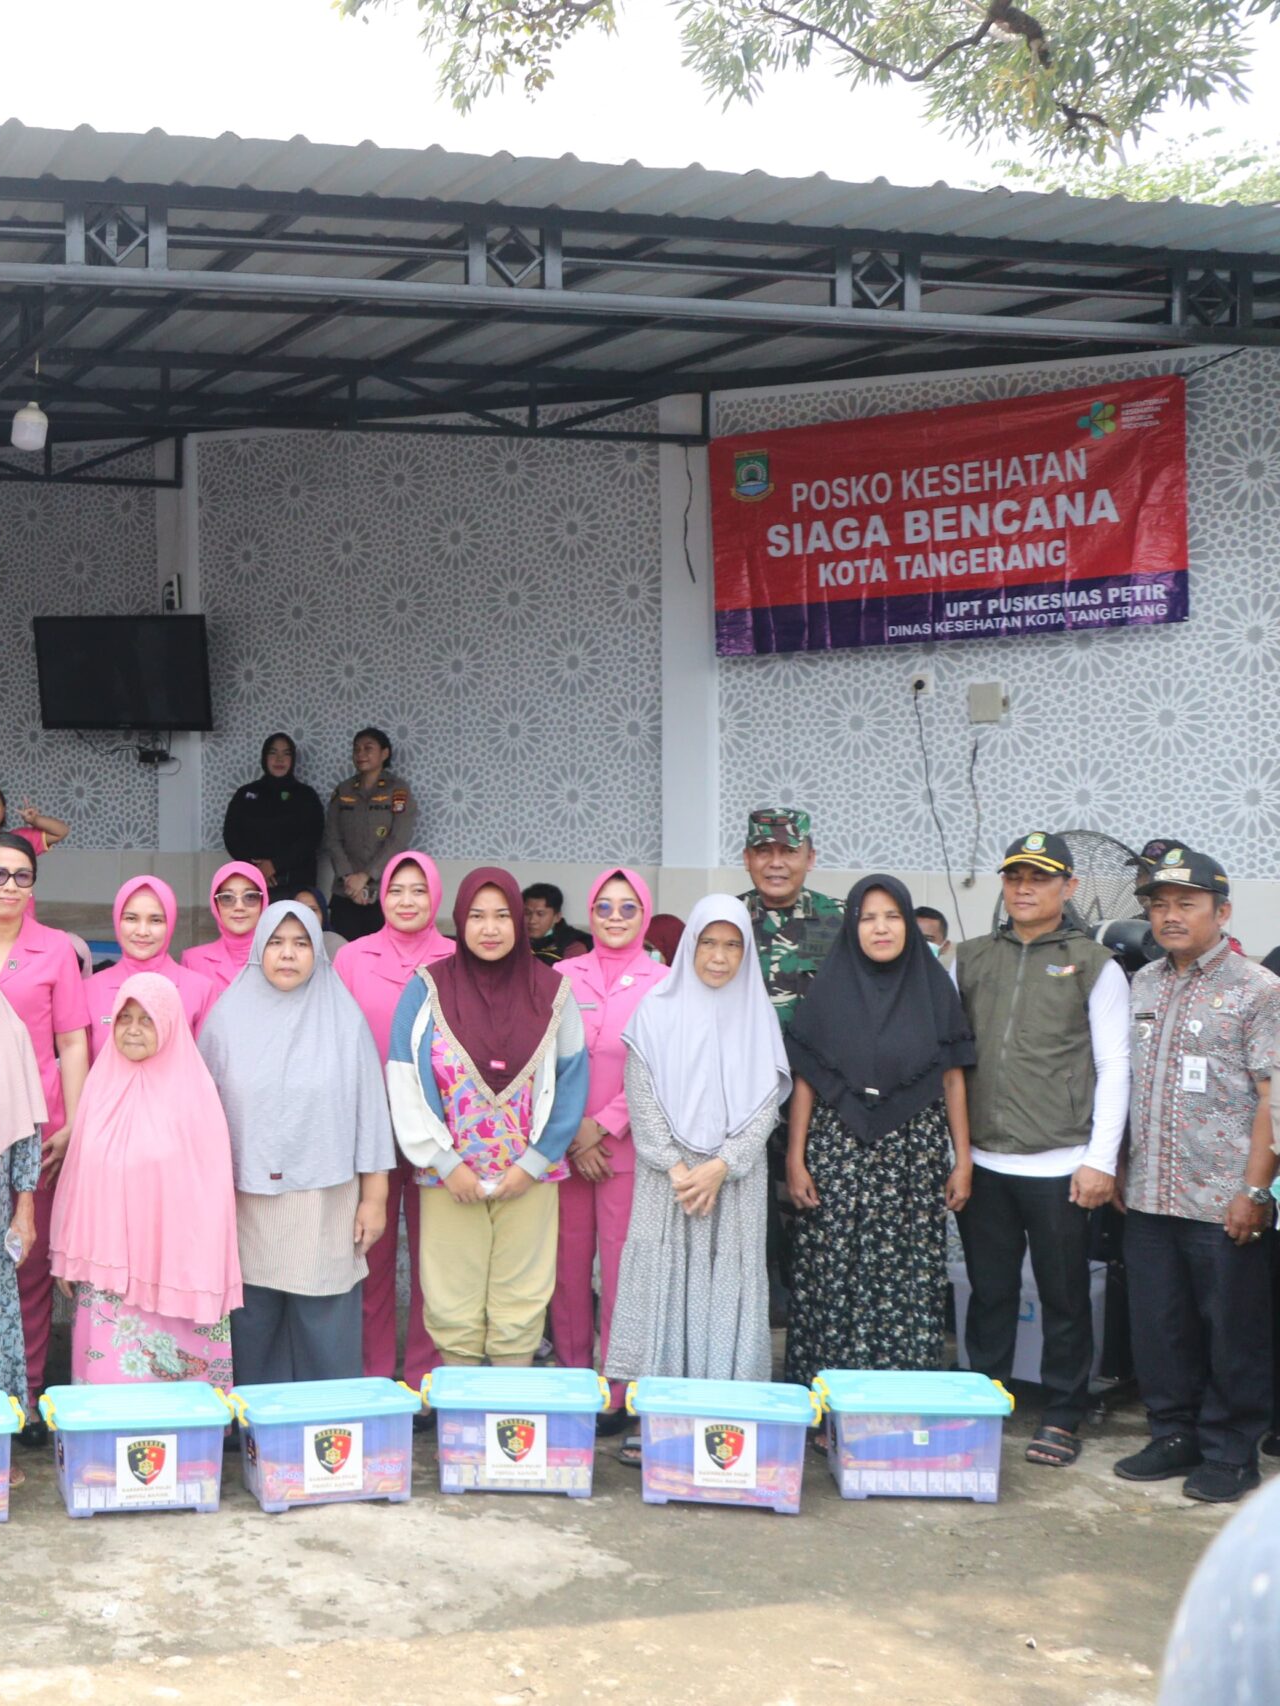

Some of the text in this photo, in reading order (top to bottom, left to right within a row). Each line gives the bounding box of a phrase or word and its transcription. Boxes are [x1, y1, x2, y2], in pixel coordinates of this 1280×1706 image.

[791, 448, 1087, 513] POSKO KESEHATAN
[767, 488, 1120, 557] SIAGA BENCANA
[818, 539, 1066, 588] KOTA TANGERANG
[888, 603, 1168, 638] DINAS KESEHATAN KOTA TANGERANG
[945, 583, 1167, 618] UPT PUSKESMAS PETIR
